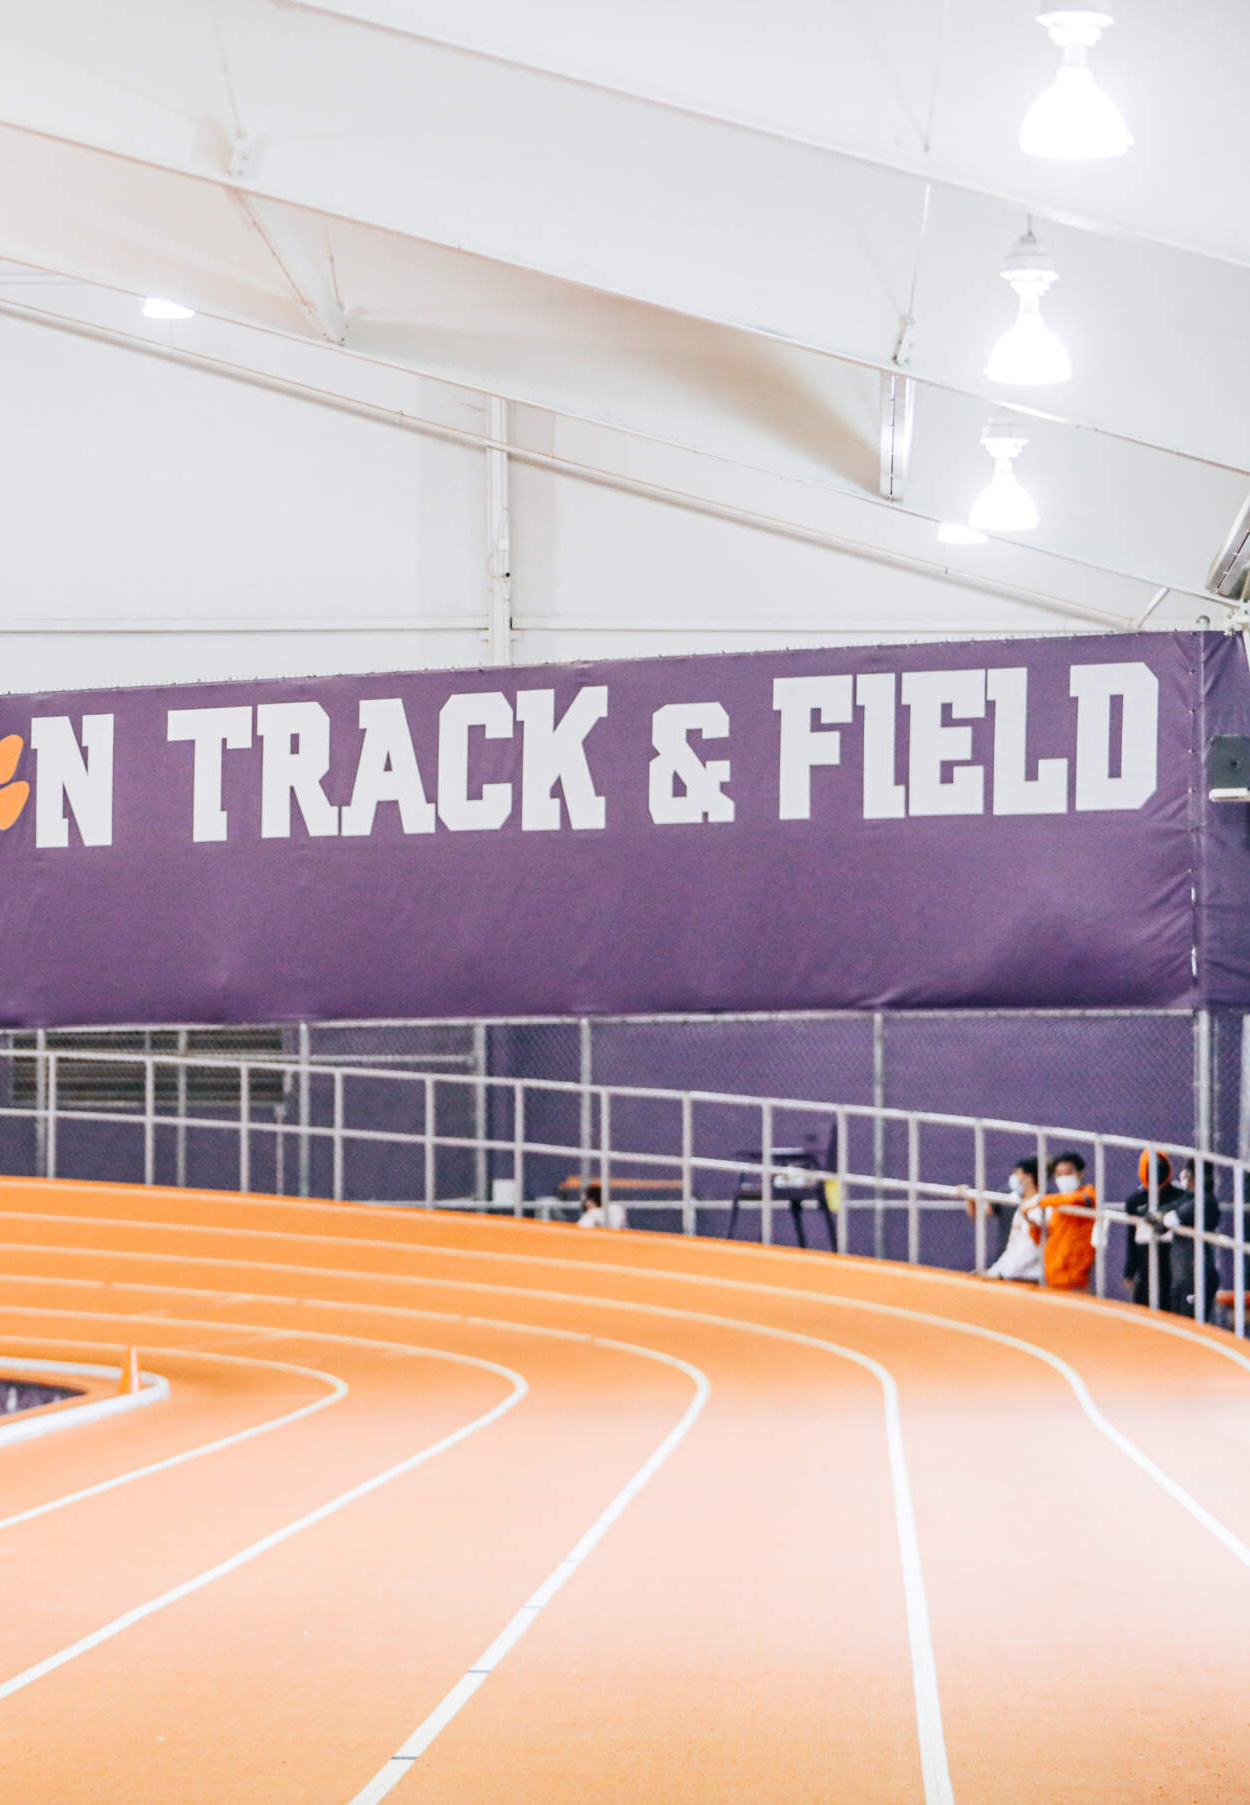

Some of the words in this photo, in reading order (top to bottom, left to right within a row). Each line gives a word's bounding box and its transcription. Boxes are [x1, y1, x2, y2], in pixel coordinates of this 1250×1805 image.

[167, 686, 609, 842] TRACK
[649, 702, 735, 824] &
[773, 662, 1159, 821] FIELD
